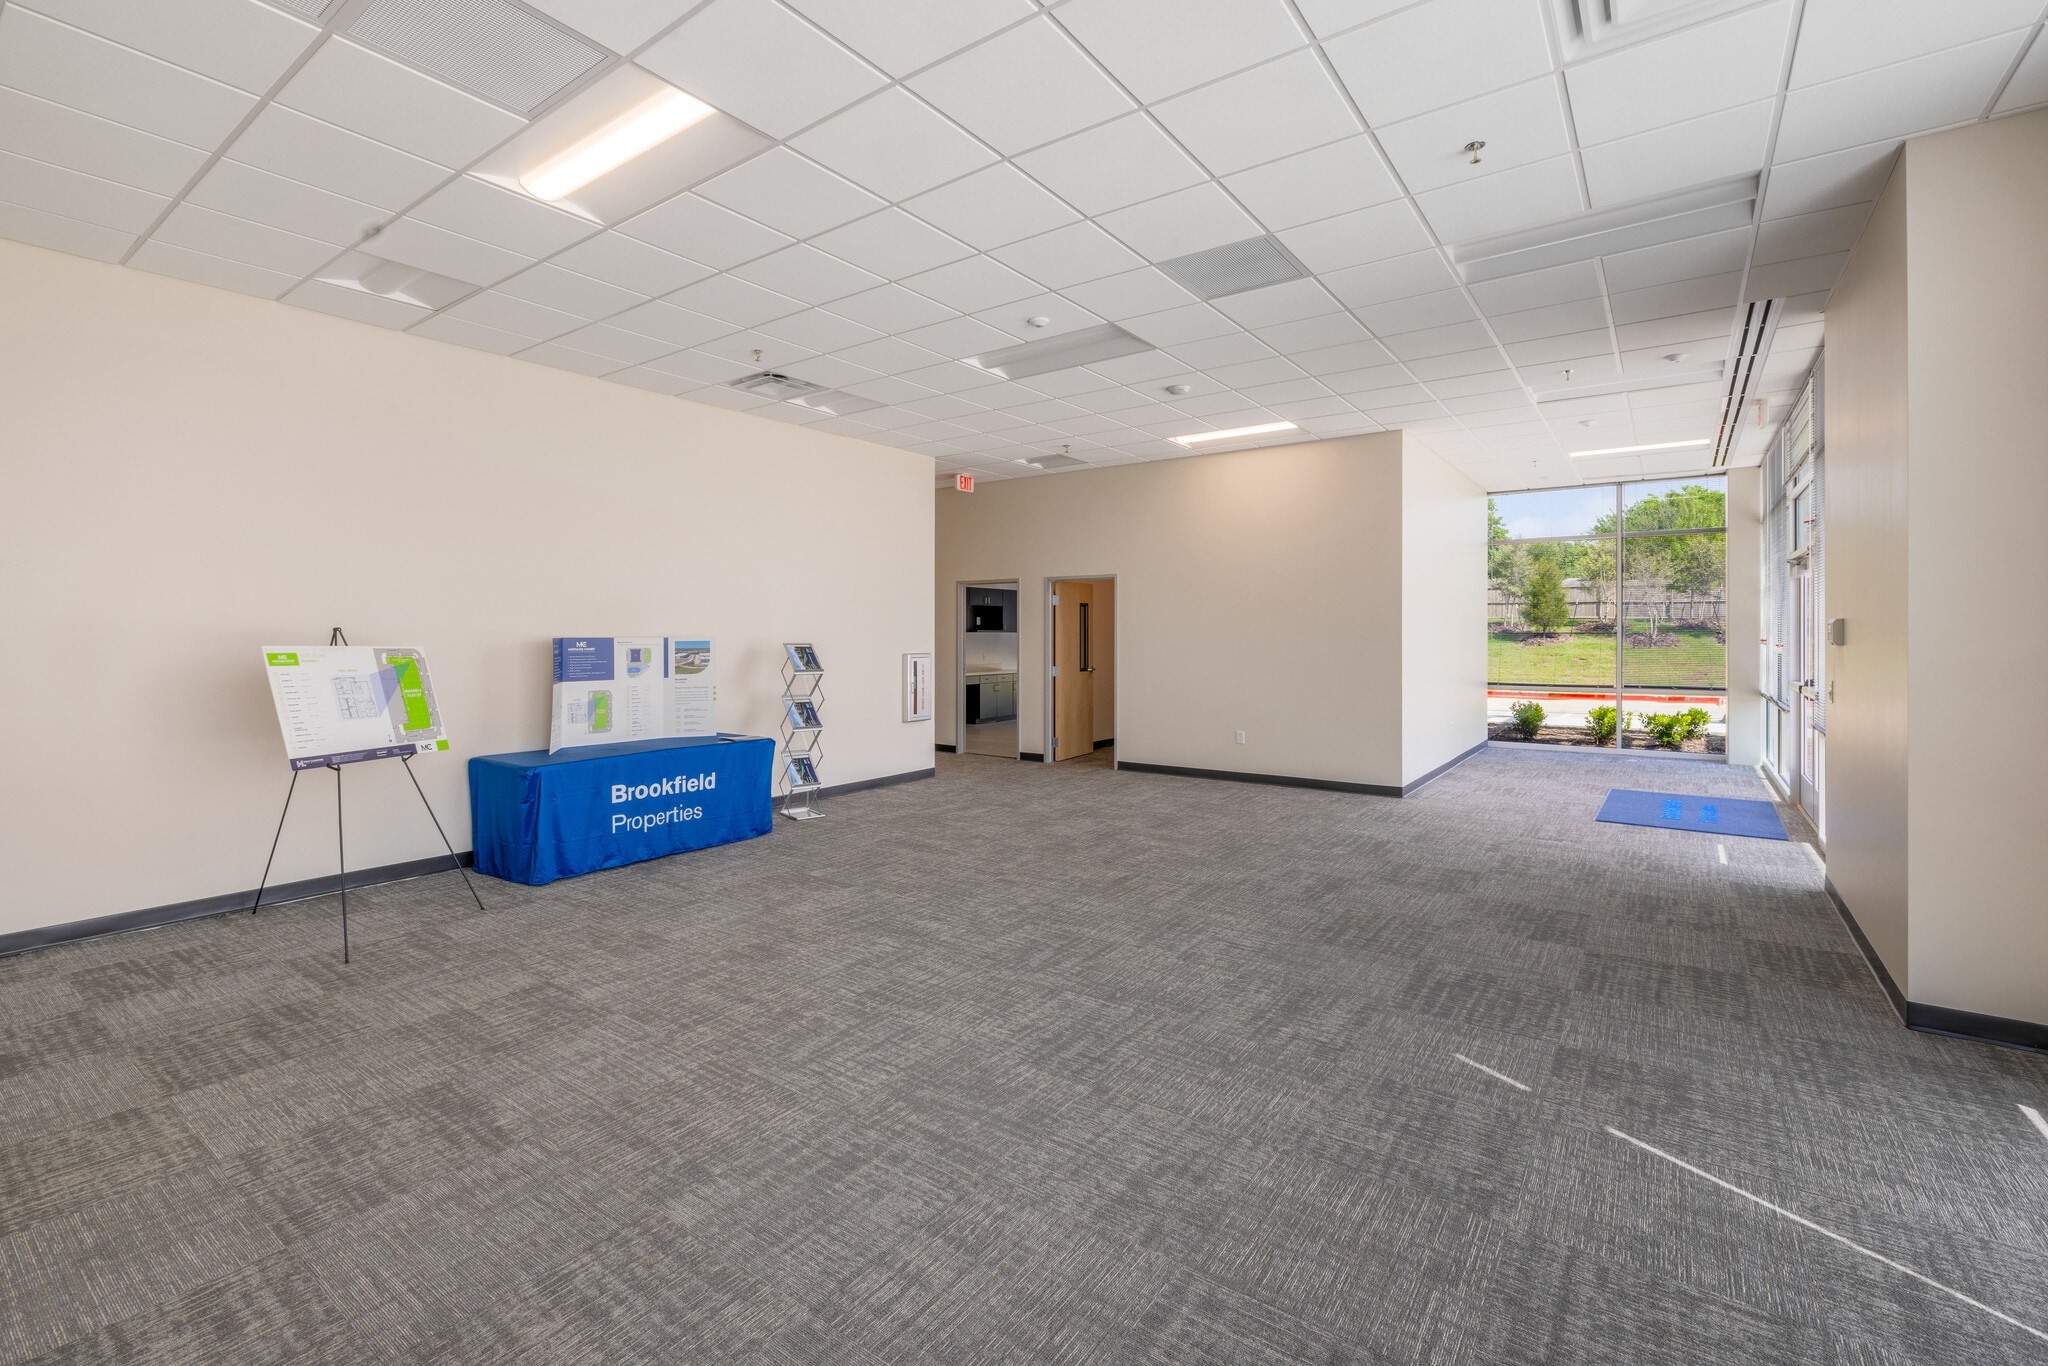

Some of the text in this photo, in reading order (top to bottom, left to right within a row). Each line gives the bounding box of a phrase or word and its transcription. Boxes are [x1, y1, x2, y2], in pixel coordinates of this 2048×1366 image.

[960, 475, 972, 491] EXIT
[420, 743, 432, 751] MC
[611, 772, 716, 804] Brookfield
[612, 804, 703, 834] Properties
